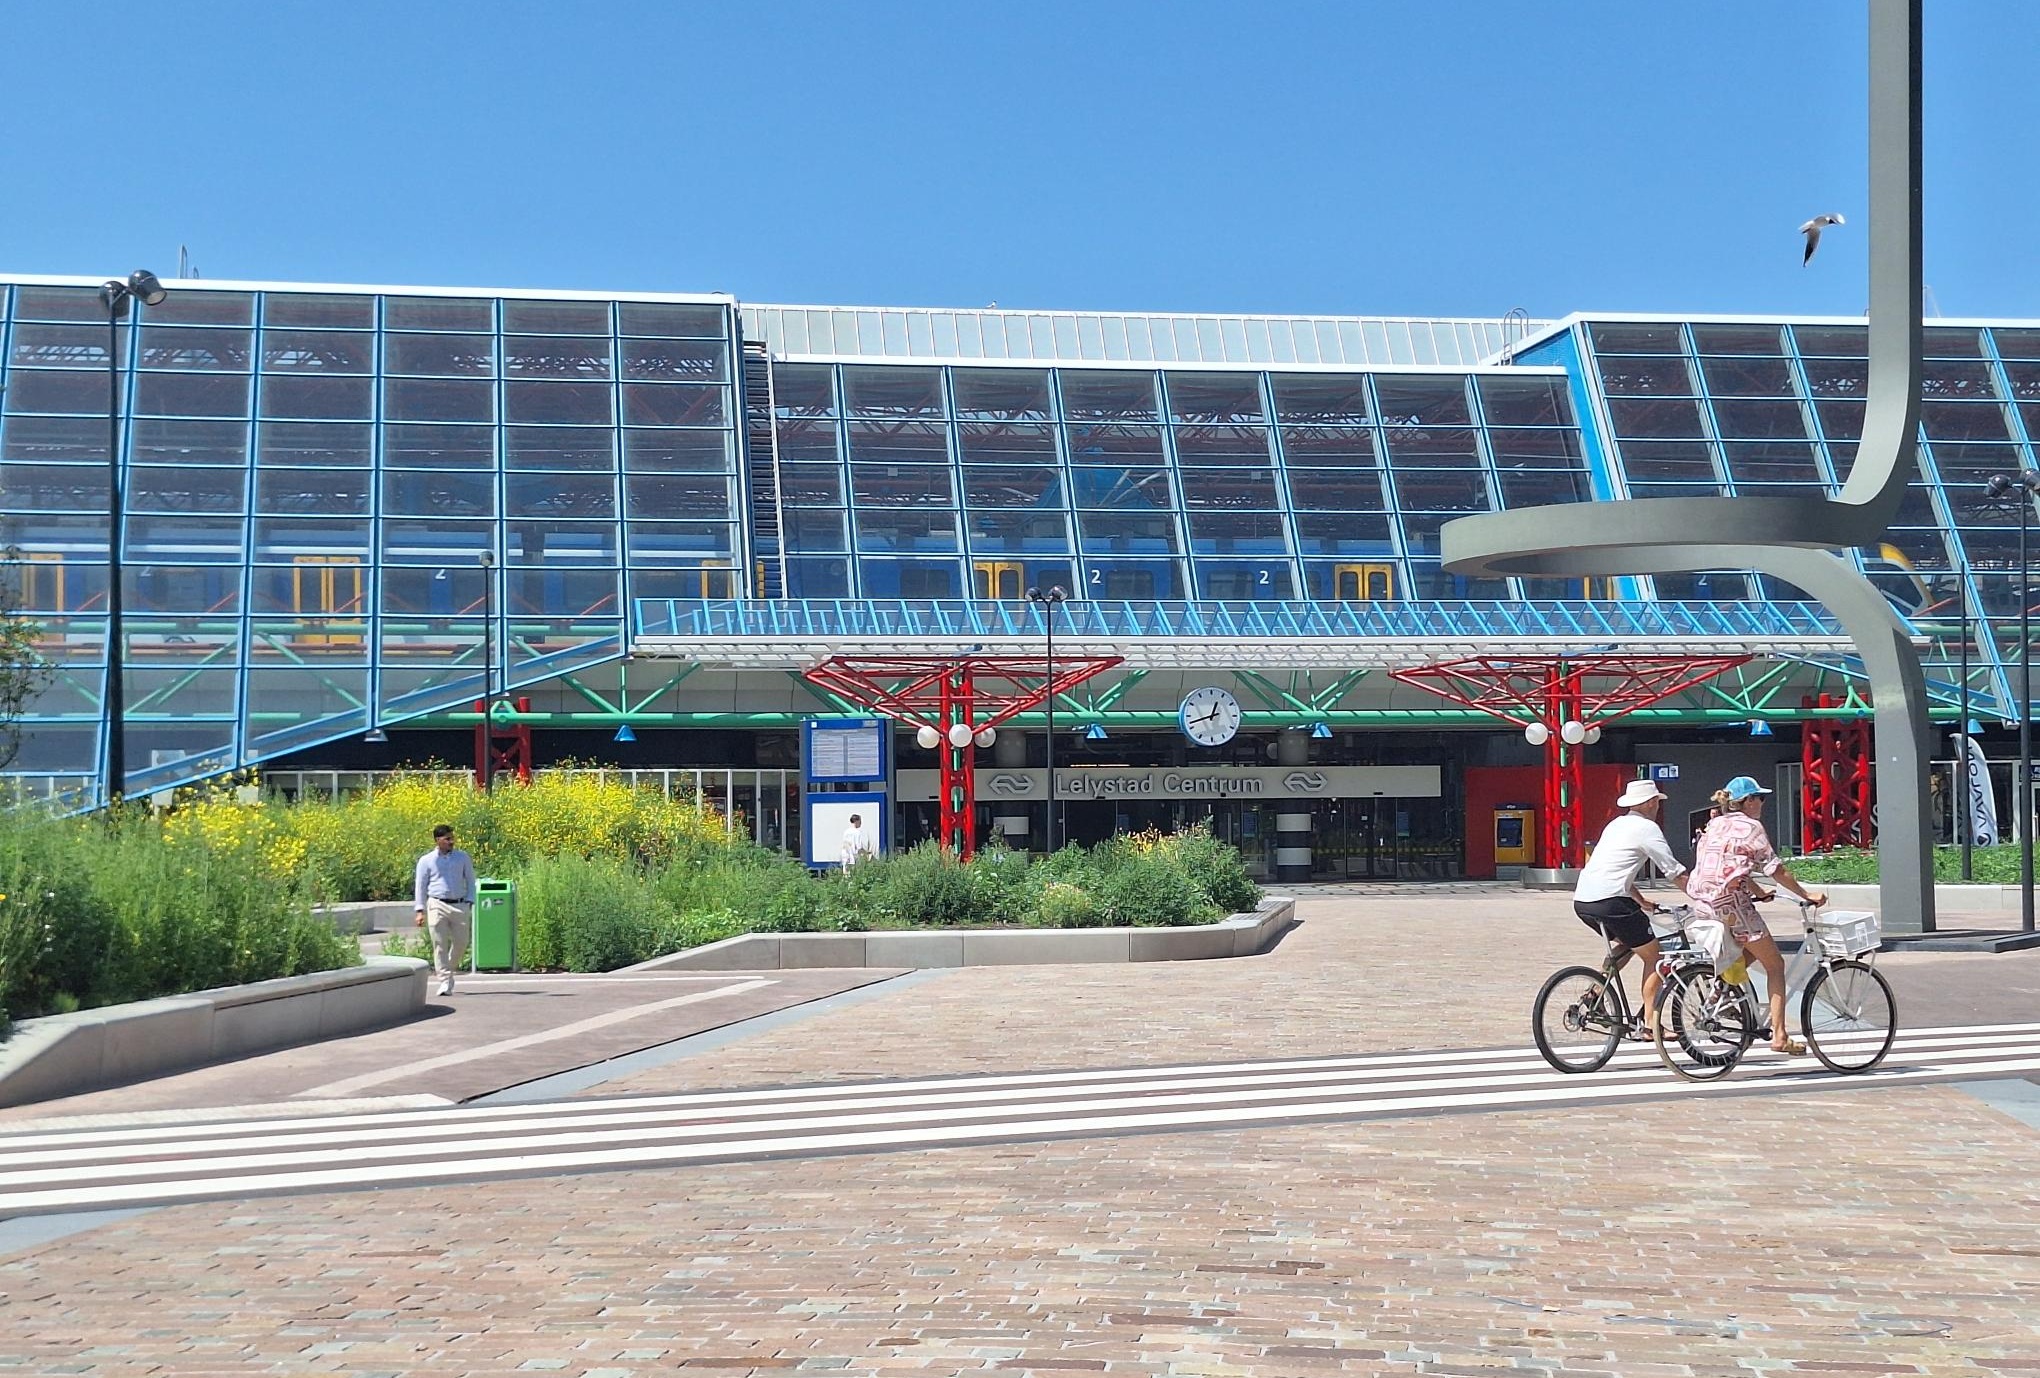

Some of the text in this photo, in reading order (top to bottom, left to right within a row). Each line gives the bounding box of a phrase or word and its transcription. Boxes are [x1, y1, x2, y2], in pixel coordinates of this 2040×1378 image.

[435, 568, 446, 580] 2
[1091, 569, 1101, 584] 2
[1259, 570, 1269, 585] 2
[1698, 574, 1708, 586] 2
[1057, 773, 1262, 798] Lelystad Centrum
